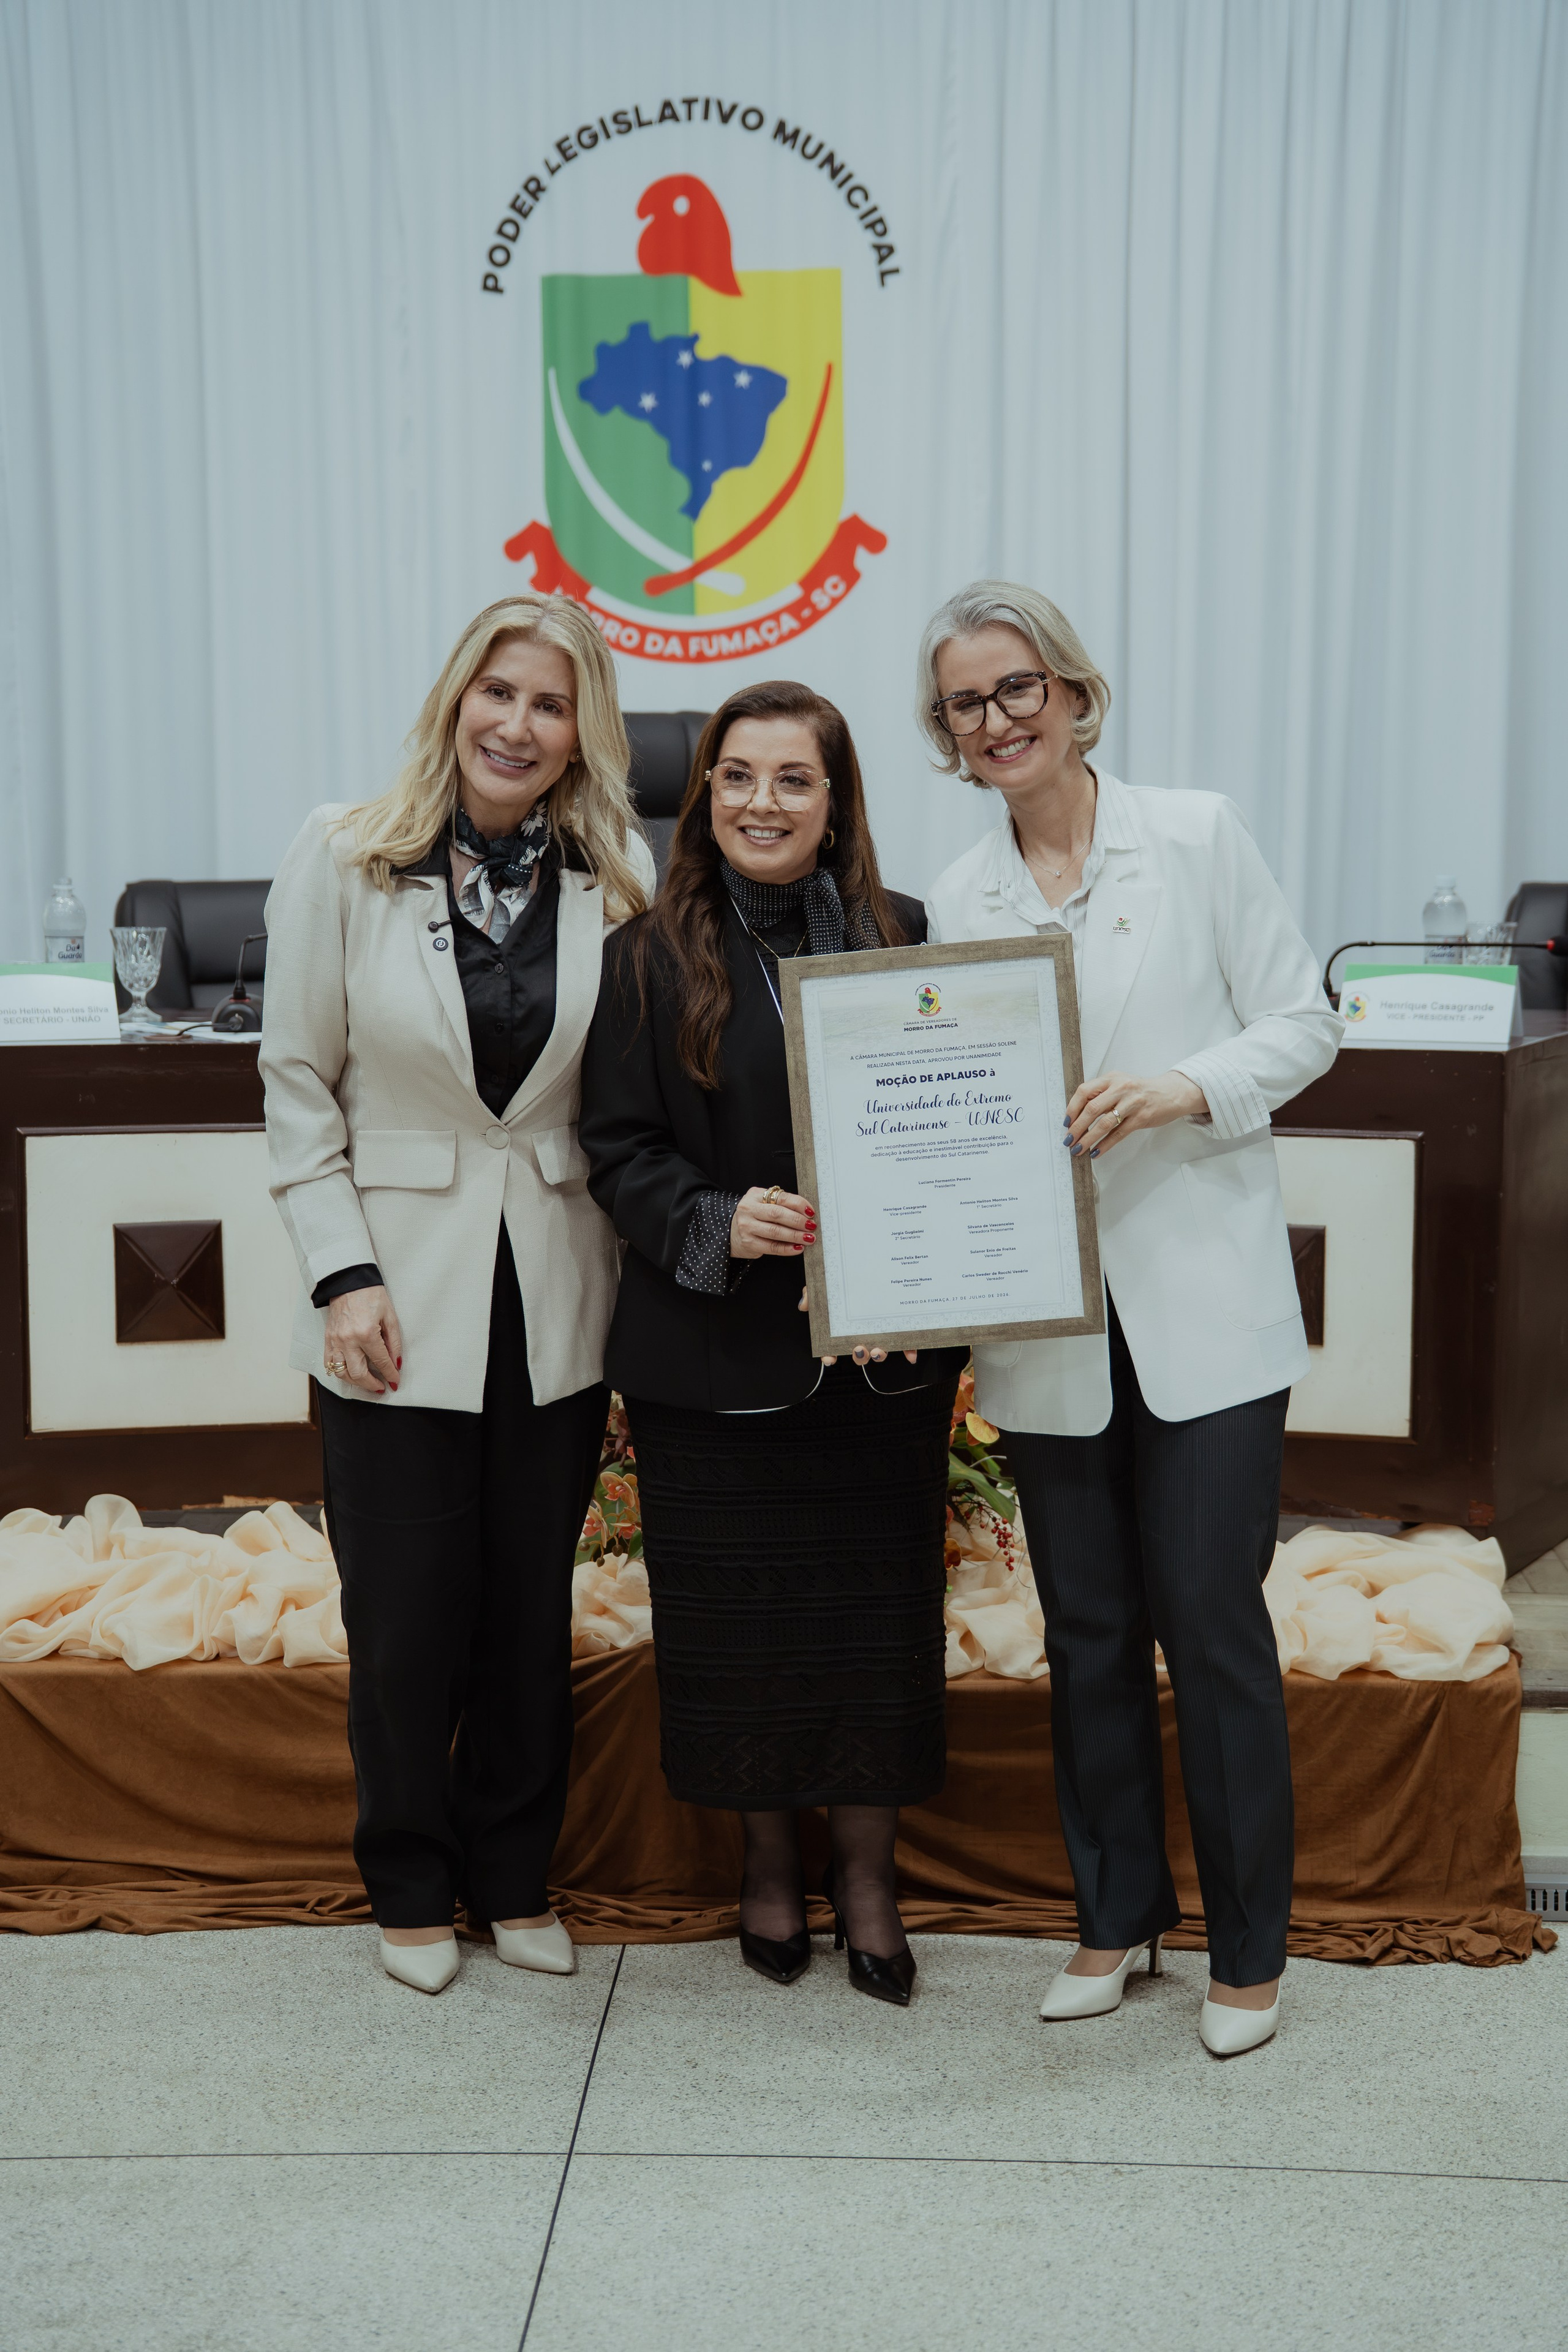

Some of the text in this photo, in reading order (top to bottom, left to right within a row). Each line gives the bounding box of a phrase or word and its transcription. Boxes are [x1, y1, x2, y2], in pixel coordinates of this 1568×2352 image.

[481, 96, 901, 295] PODER LEGISLATIVO MUNICIPAL
[644, 632, 684, 658] DA
[688, 611, 801, 658] FUMAÇA
[810, 575, 847, 611] SC
[58, 951, 82, 959] Guarda
[1380, 1001, 1494, 1012] Henrique Casagrande
[3, 1015, 64, 1024] SECRETÁRIO
[72, 1014, 101, 1023] UNIÃO
[876, 1068, 995, 1088] MOÇÃO DE APLAUSO à
[864, 1090, 1012, 1114] Universidade do Extremo
[856, 1121, 879, 1137] Sul
[880, 1118, 950, 1134] Catarinense
[966, 1107, 1024, 1126] UNESC
